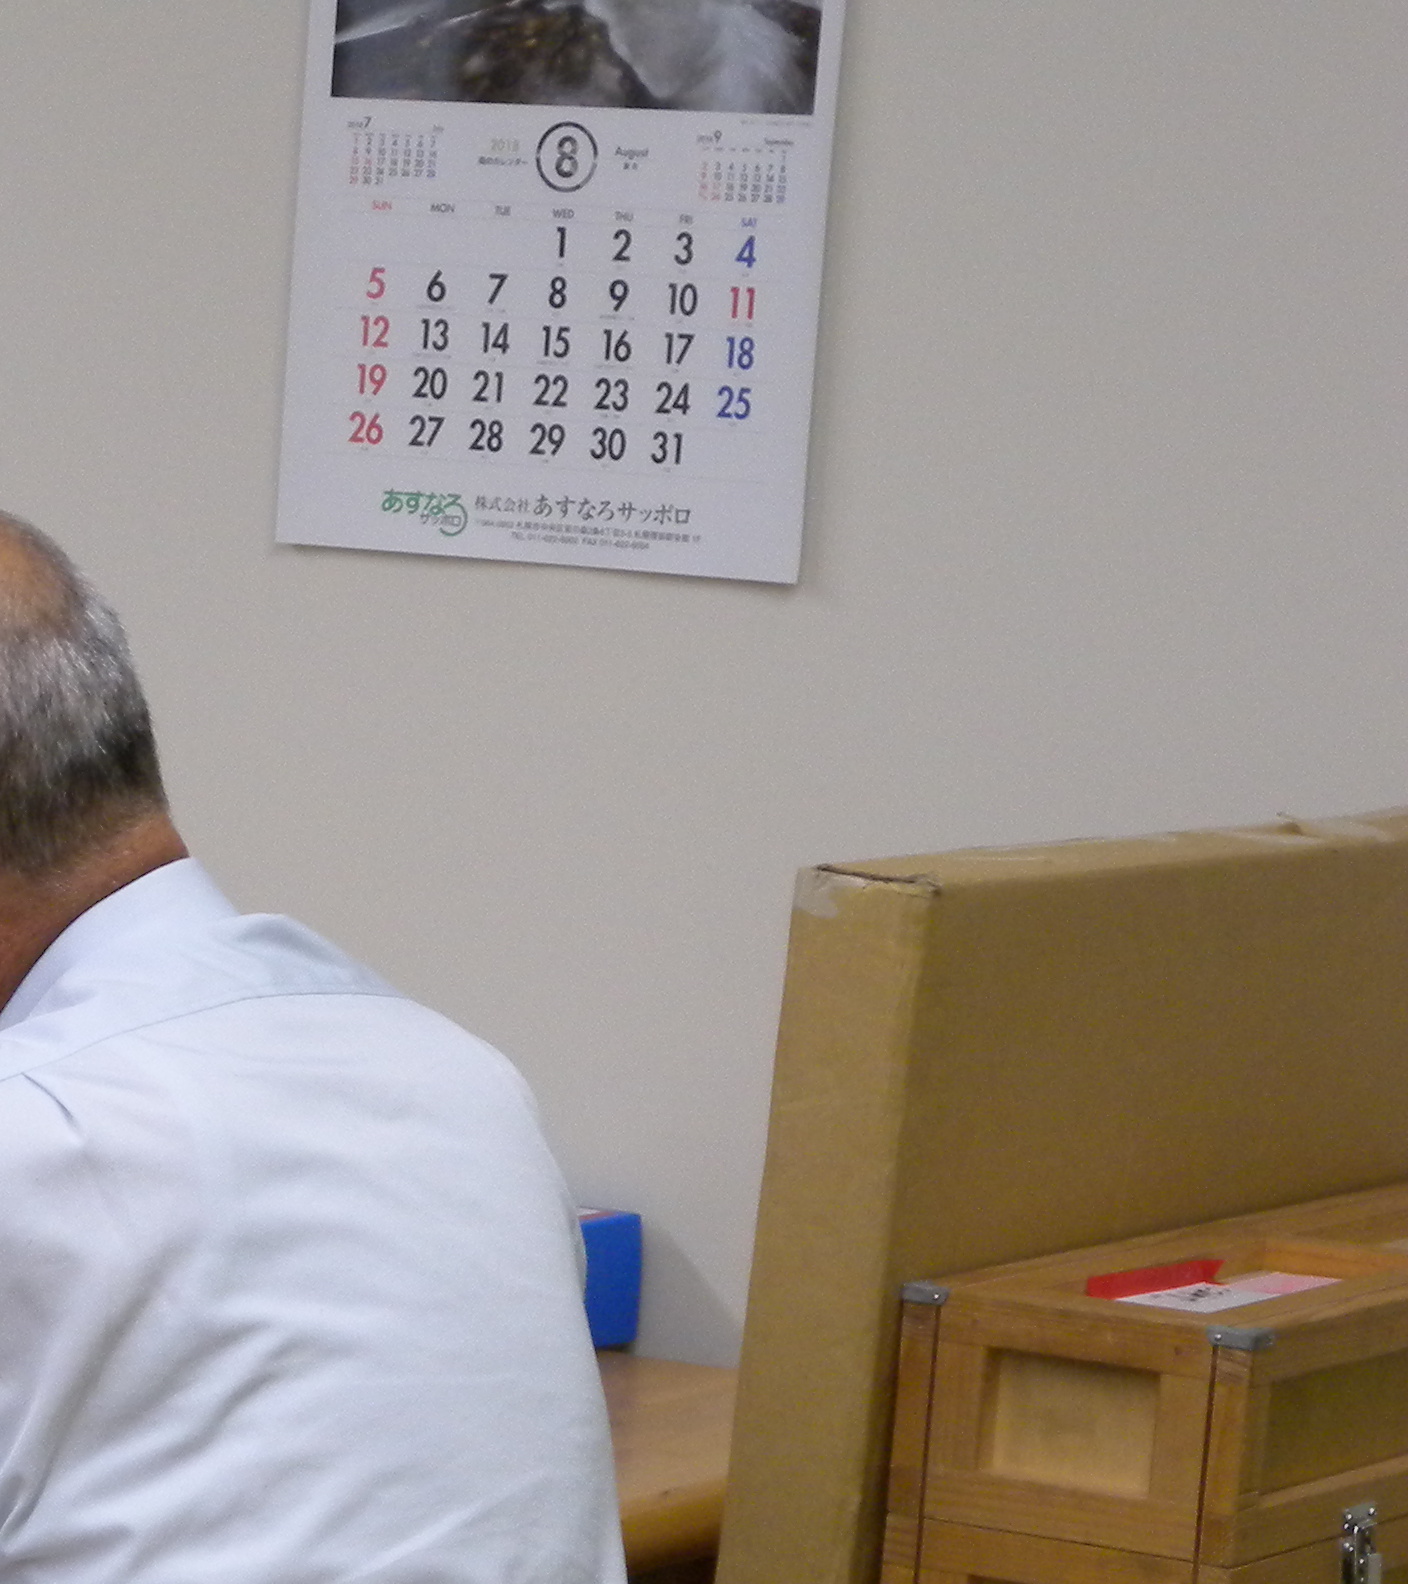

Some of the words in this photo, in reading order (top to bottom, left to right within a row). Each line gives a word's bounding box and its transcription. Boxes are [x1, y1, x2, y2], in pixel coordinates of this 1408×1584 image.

[554, 135, 579, 179] 8
[614, 146, 650, 160] August
[556, 226, 567, 259] 1
[612, 228, 632, 263] 2
[673, 231, 694, 266] 3
[734, 235, 757, 269] 4
[366, 267, 386, 300] 5
[426, 269, 447, 303] 6
[487, 272, 509, 305] 7
[547, 275, 568, 310] 8
[608, 278, 630, 313] 9
[668, 282, 699, 317] 10
[730, 286, 756, 320] 11
[360, 315, 390, 348] 12
[420, 318, 450, 352] 13
[481, 321, 510, 355] 14
[542, 324, 571, 359] 15
[602, 328, 632, 363] 16
[664, 332, 695, 366] 17
[726, 336, 755, 371] 18
[357, 363, 388, 396] 19
[411, 365, 448, 401] 20
[471, 369, 504, 404] 21
[532, 373, 569, 408] 22
[593, 377, 630, 413] 23
[654, 381, 691, 416] 24
[716, 385, 752, 421] 25
[348, 410, 384, 446] 26
[408, 414, 446, 448] 27
[468, 418, 504, 453] 28
[528, 422, 566, 457] 29
[589, 426, 627, 462] 30
[650, 430, 683, 466] 31
